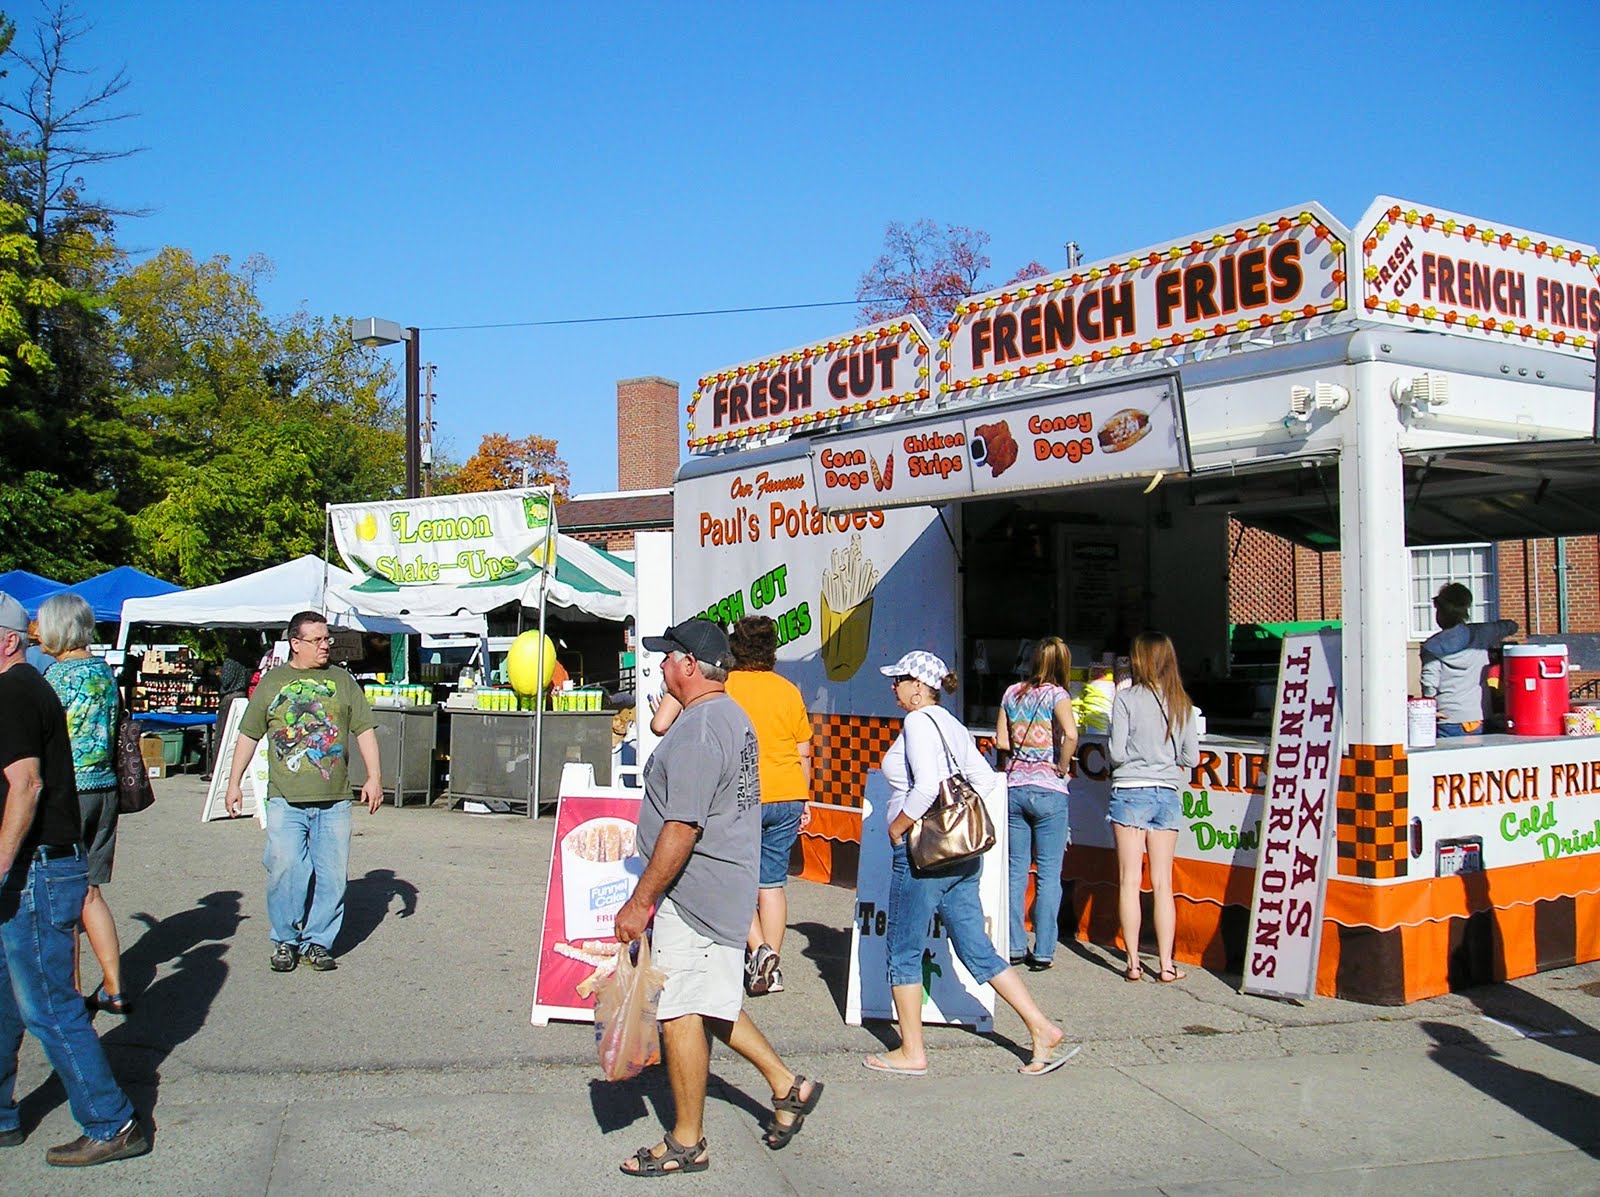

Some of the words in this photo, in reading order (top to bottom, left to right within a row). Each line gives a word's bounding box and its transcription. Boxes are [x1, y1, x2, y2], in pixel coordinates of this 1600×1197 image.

[1371, 235, 1415, 293] FRESH
[1393, 259, 1419, 297] CUT
[971, 281, 1136, 370] FRENCH
[1155, 239, 1303, 329] FRIES
[1421, 250, 1527, 319] FRENCH
[1536, 276, 1600, 334] FRIES
[713, 365, 812, 428] FRESH
[828, 342, 899, 401] CUT
[904, 431, 966, 454] Chicken
[1028, 411, 1094, 435] Coney
[820, 448, 866, 469] Corn
[908, 453, 963, 480] Strips
[1034, 437, 1094, 463] Dogs
[730, 476, 754, 500] Our
[755, 471, 806, 501] Famous
[824, 470, 870, 491] Dogs
[390, 511, 494, 544] Lemon
[700, 507, 760, 548] Paul's
[375, 549, 519, 583] Shake-Ups
[750, 563, 787, 610] CUT
[774, 601, 812, 648] IES
[1185, 749, 1268, 794] RIE
[1432, 766, 1539, 811] FRENCH
[1550, 760, 1600, 798] FRIE
[1251, 646, 1312, 979] TENDERLOINS
[1286, 686, 1337, 939] TEXAS
[1500, 801, 1558, 842] Cold
[591, 881, 626, 900] Funnel
[595, 891, 628, 908] Cake
